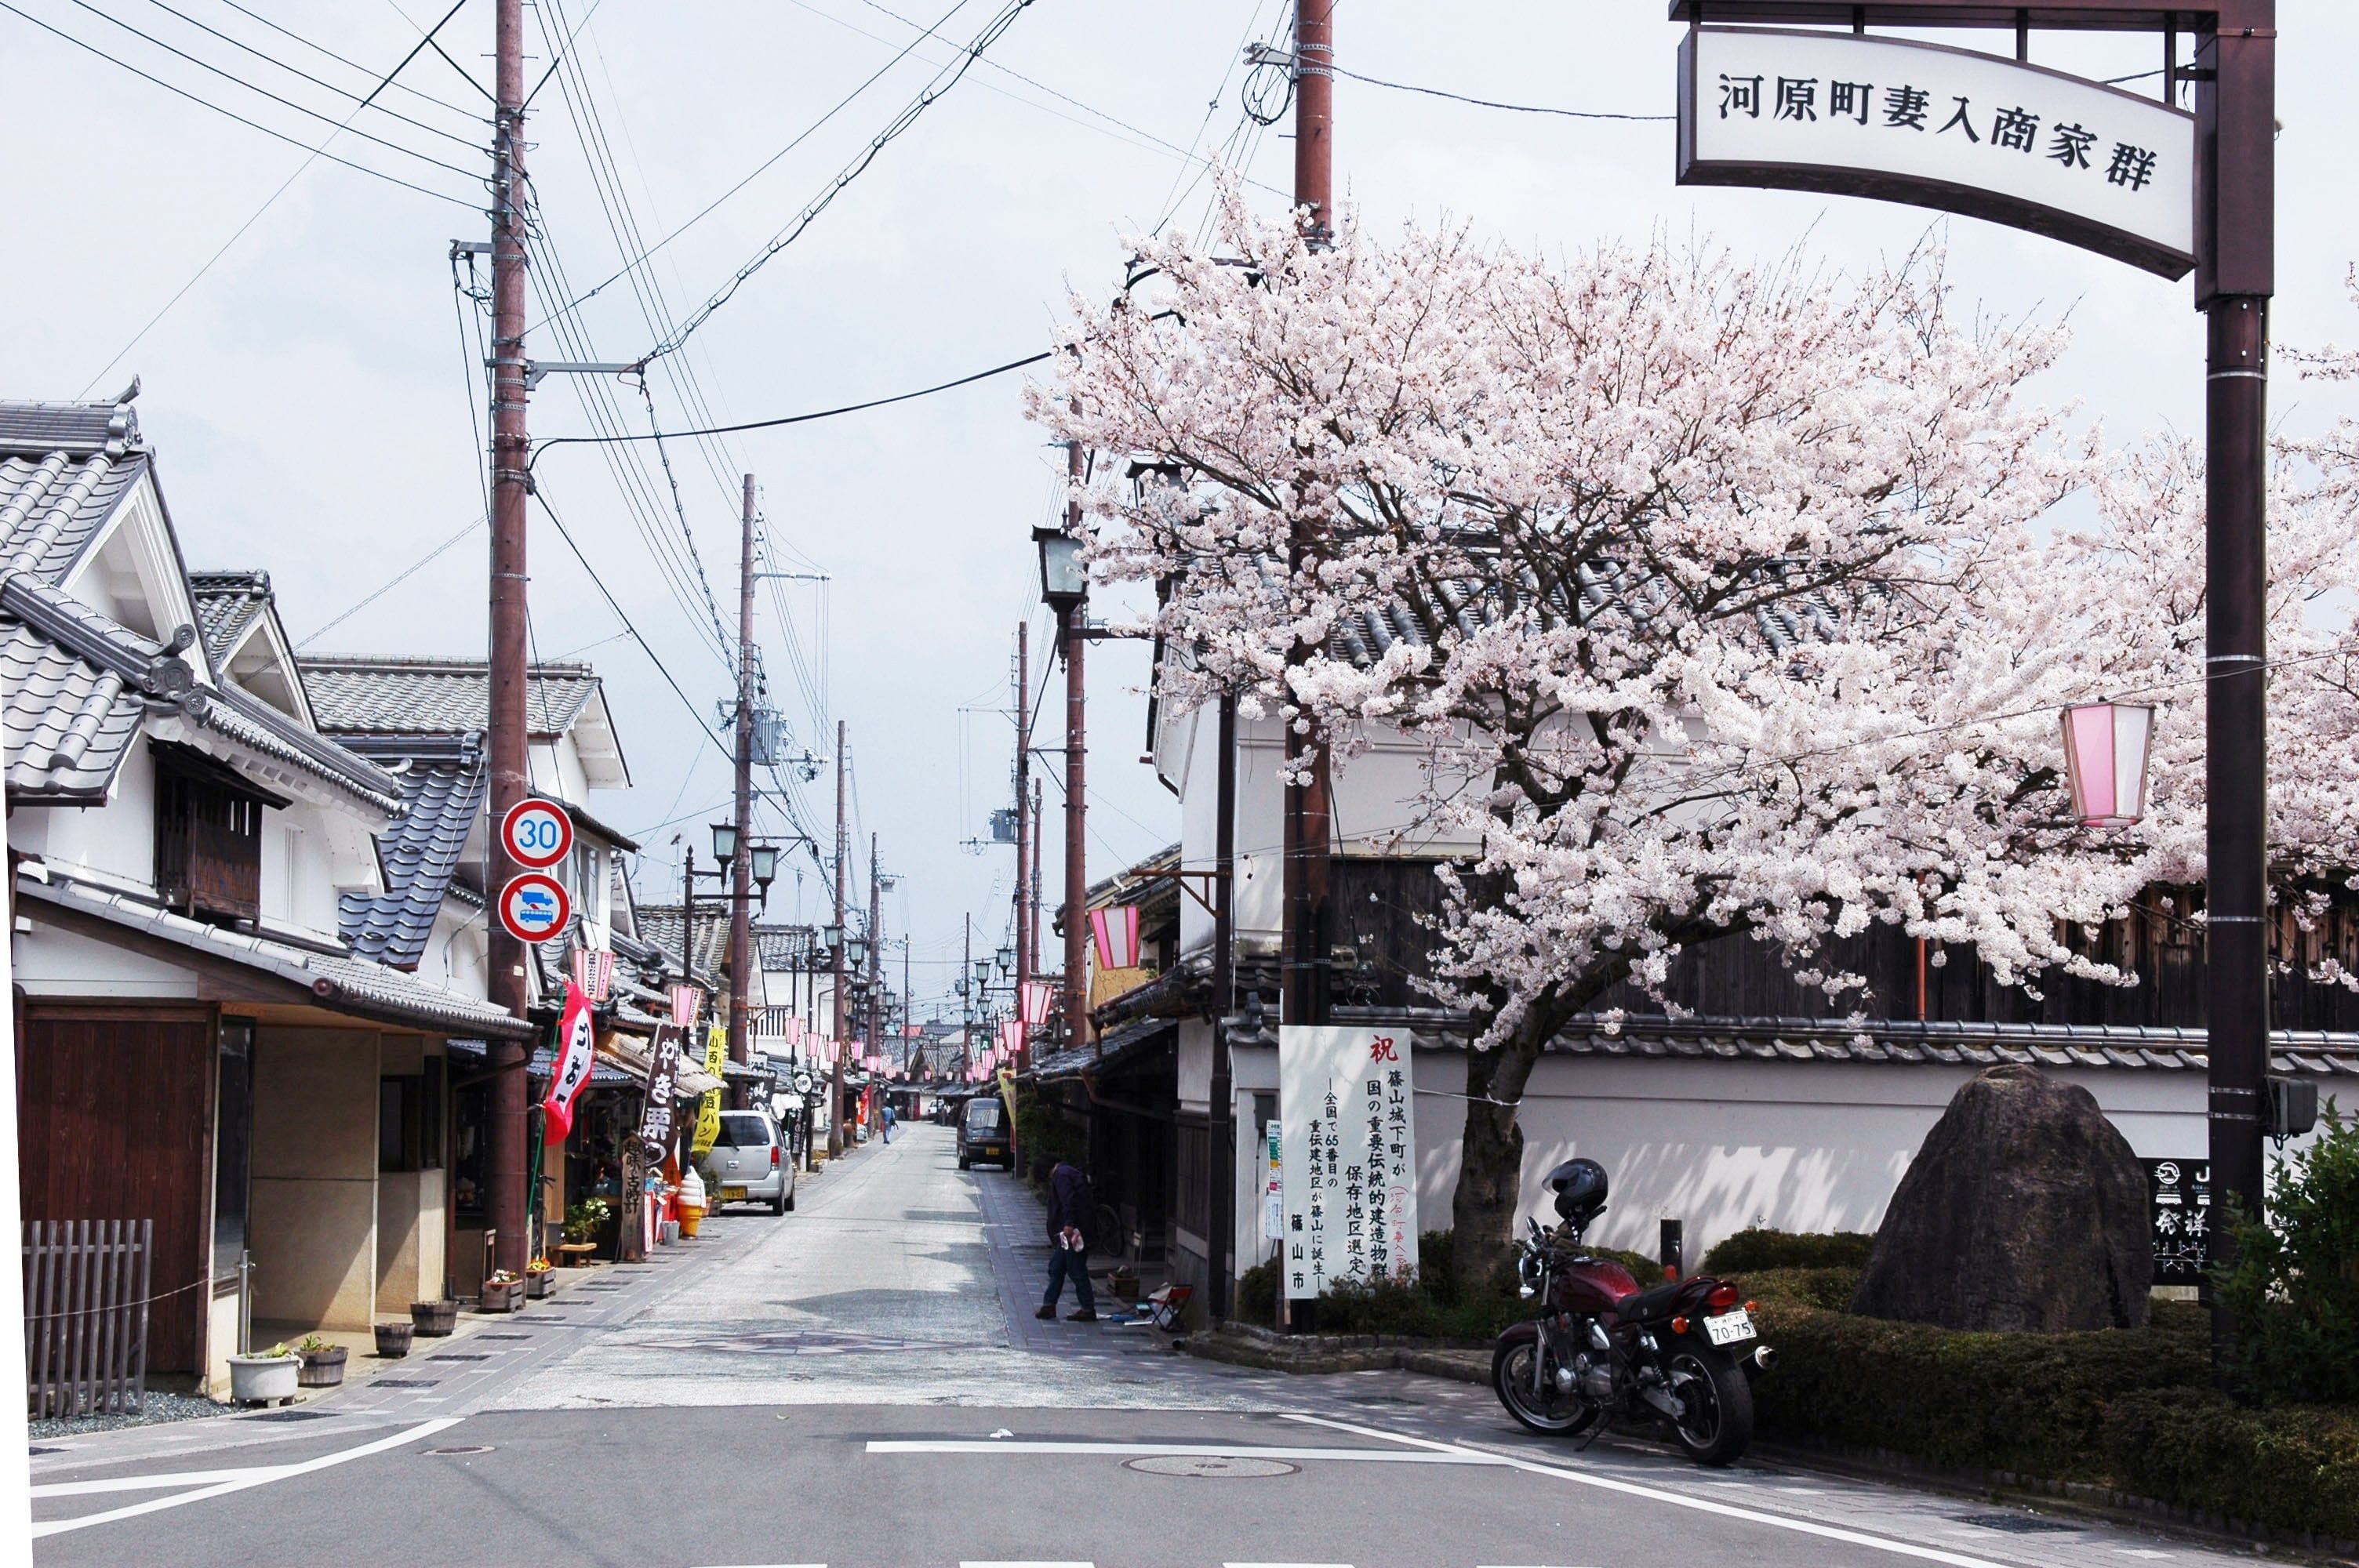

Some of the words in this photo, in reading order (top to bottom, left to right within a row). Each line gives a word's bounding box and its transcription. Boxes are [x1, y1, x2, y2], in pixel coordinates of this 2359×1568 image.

[1717, 72, 2158, 192] 河原町妻入商家群
[519, 819, 557, 850] 30
[1369, 1034, 1400, 1065] 祝
[642, 1037, 675, 1141] やき栗
[1387, 1070, 1408, 1177] 篠山城下町が
[1291, 1214, 1304, 1290] 篠山市
[1712, 1322, 1751, 1341] 70-75
